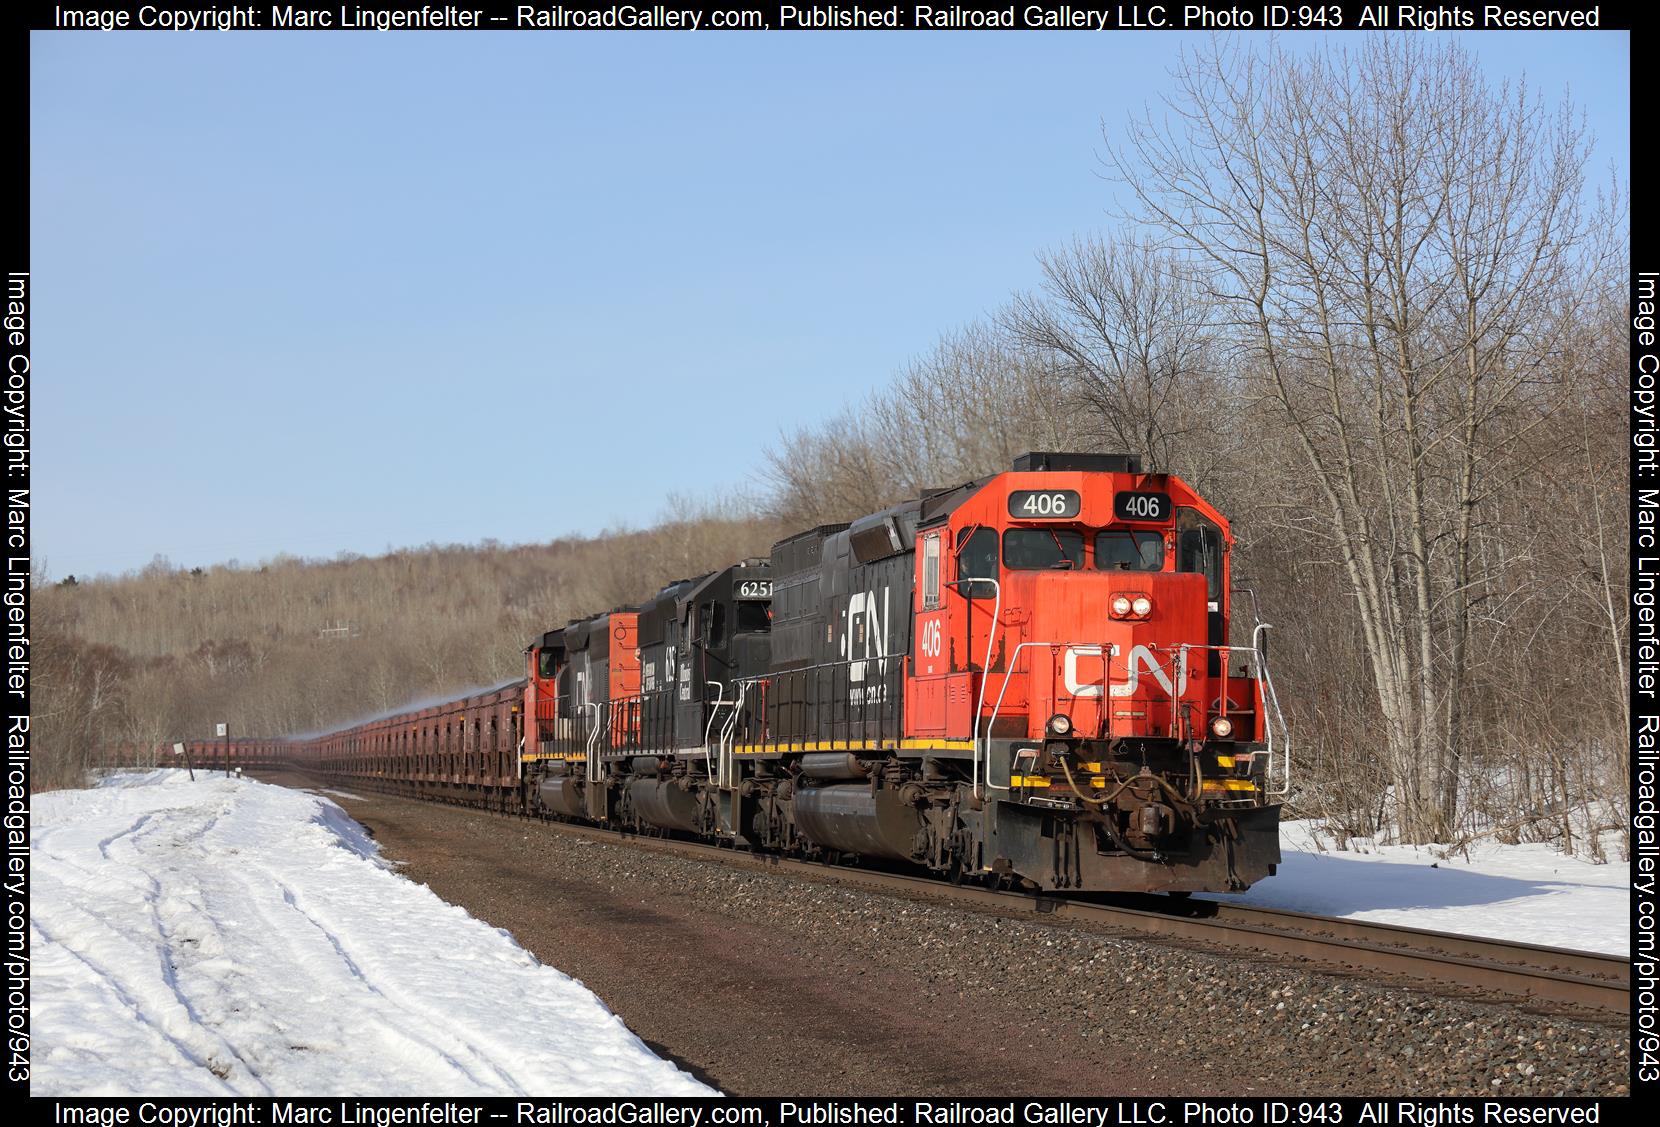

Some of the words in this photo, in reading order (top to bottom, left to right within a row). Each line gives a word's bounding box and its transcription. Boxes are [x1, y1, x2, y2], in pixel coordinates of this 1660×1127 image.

[1023, 494, 1066, 514] 406
[1125, 495, 1160, 517] 406
[741, 581, 773, 596] 6251
[848, 586, 889, 682] CN
[922, 619, 941, 657] 406
[1064, 644, 1187, 697] CN
[849, 683, 887, 706] wwcn.ca
